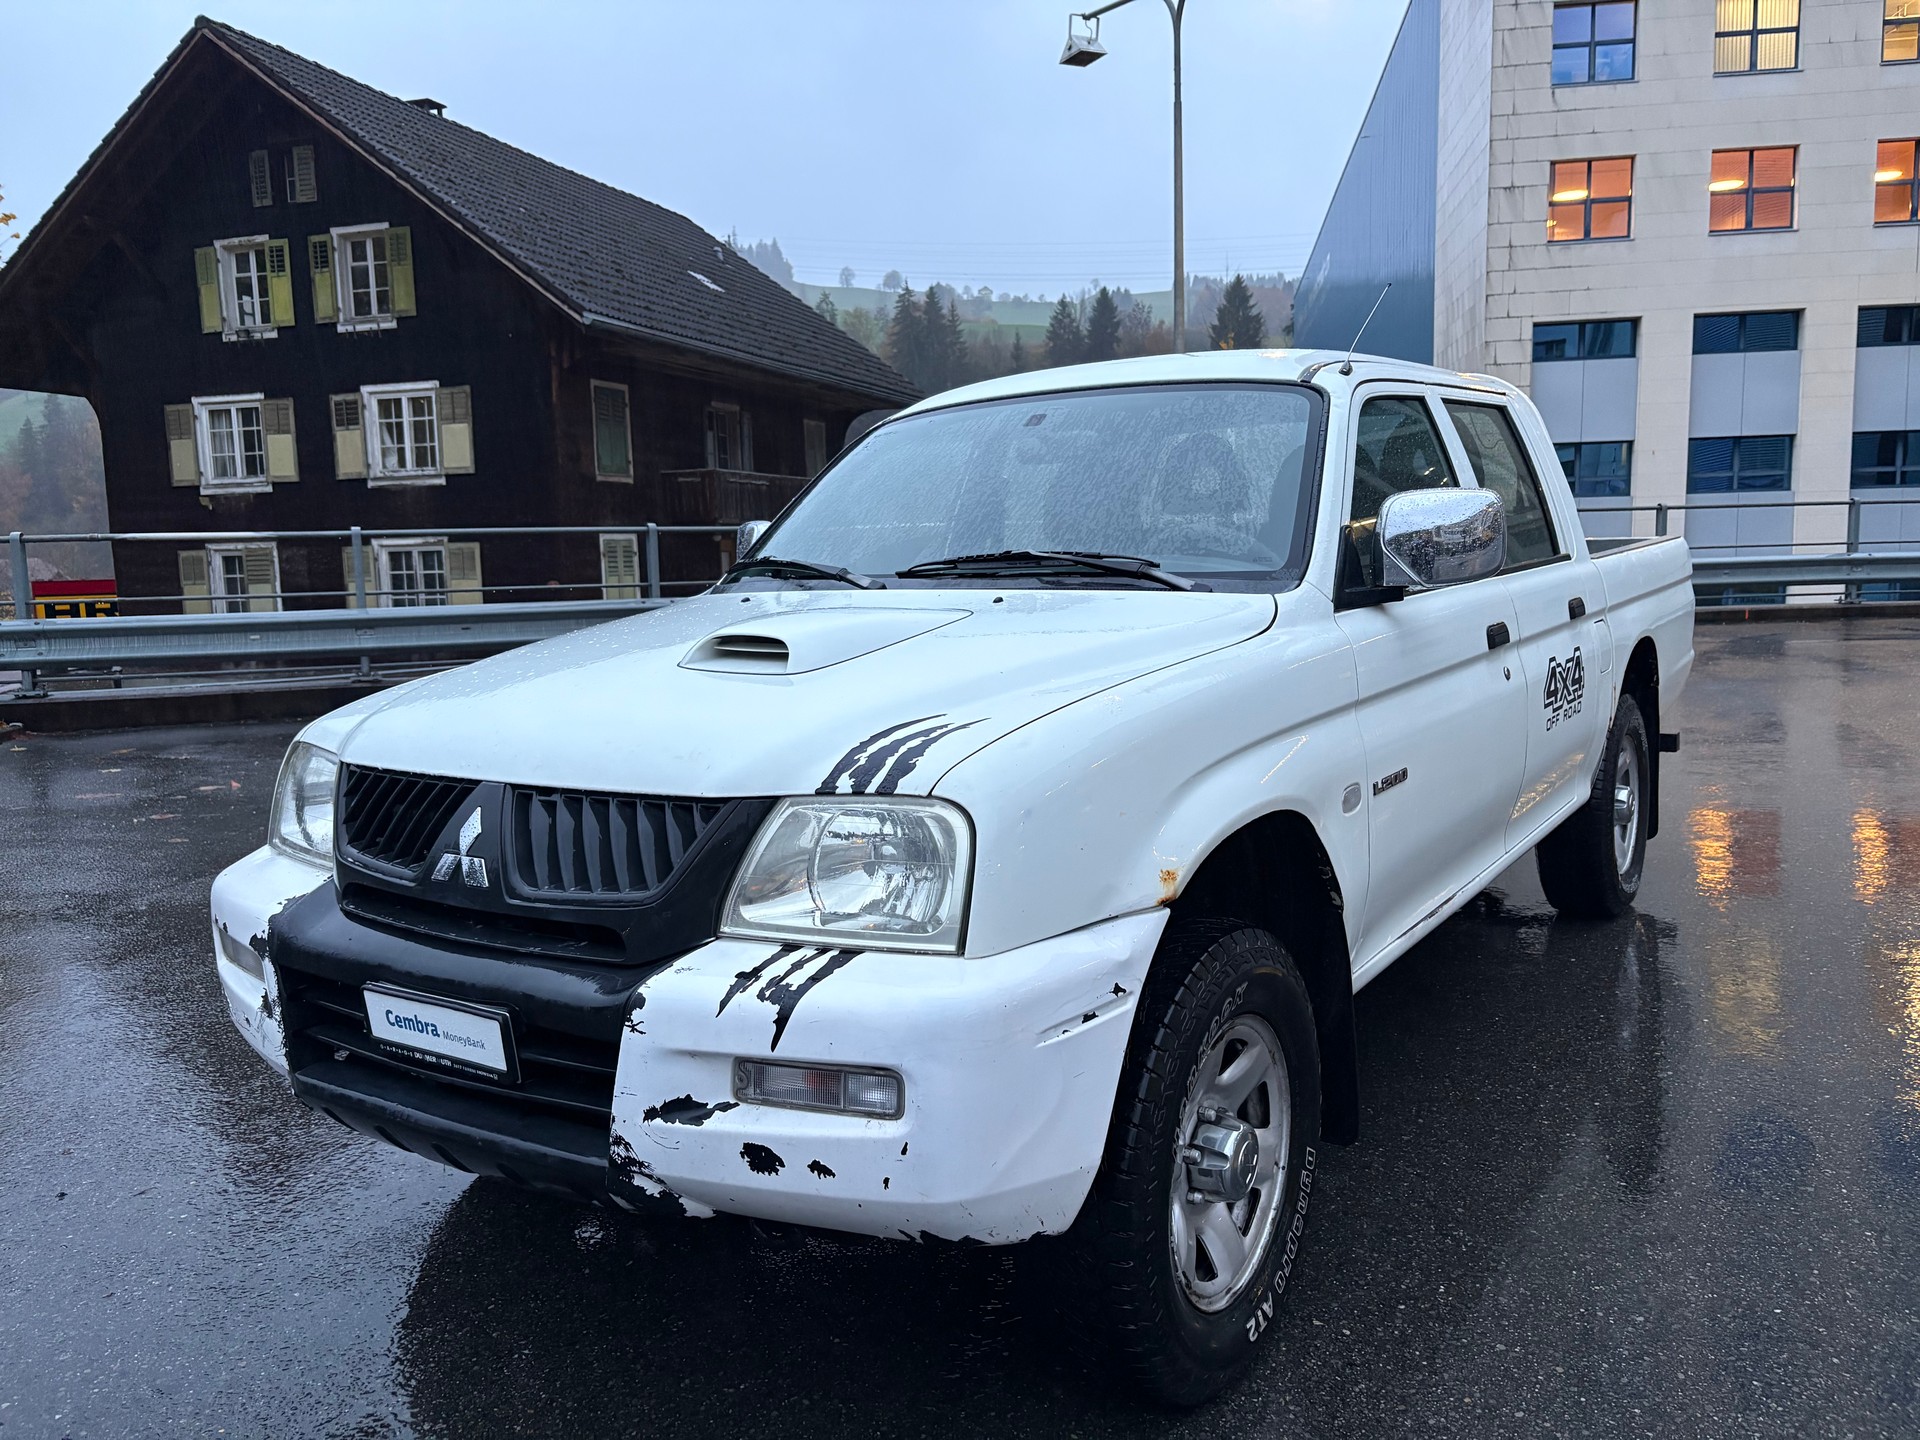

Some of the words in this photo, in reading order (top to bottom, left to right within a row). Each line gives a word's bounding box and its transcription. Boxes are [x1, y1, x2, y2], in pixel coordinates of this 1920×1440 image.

[1545, 712, 1561, 732] OFF
[1563, 700, 1582, 722] ROAD
[1372, 766, 1408, 797] L200
[385, 1009, 441, 1038] Cembra
[442, 1030, 486, 1051] MoneyBank
[1273, 1145, 1317, 1295] Dynapro
[1245, 1290, 1275, 1343] AT2
